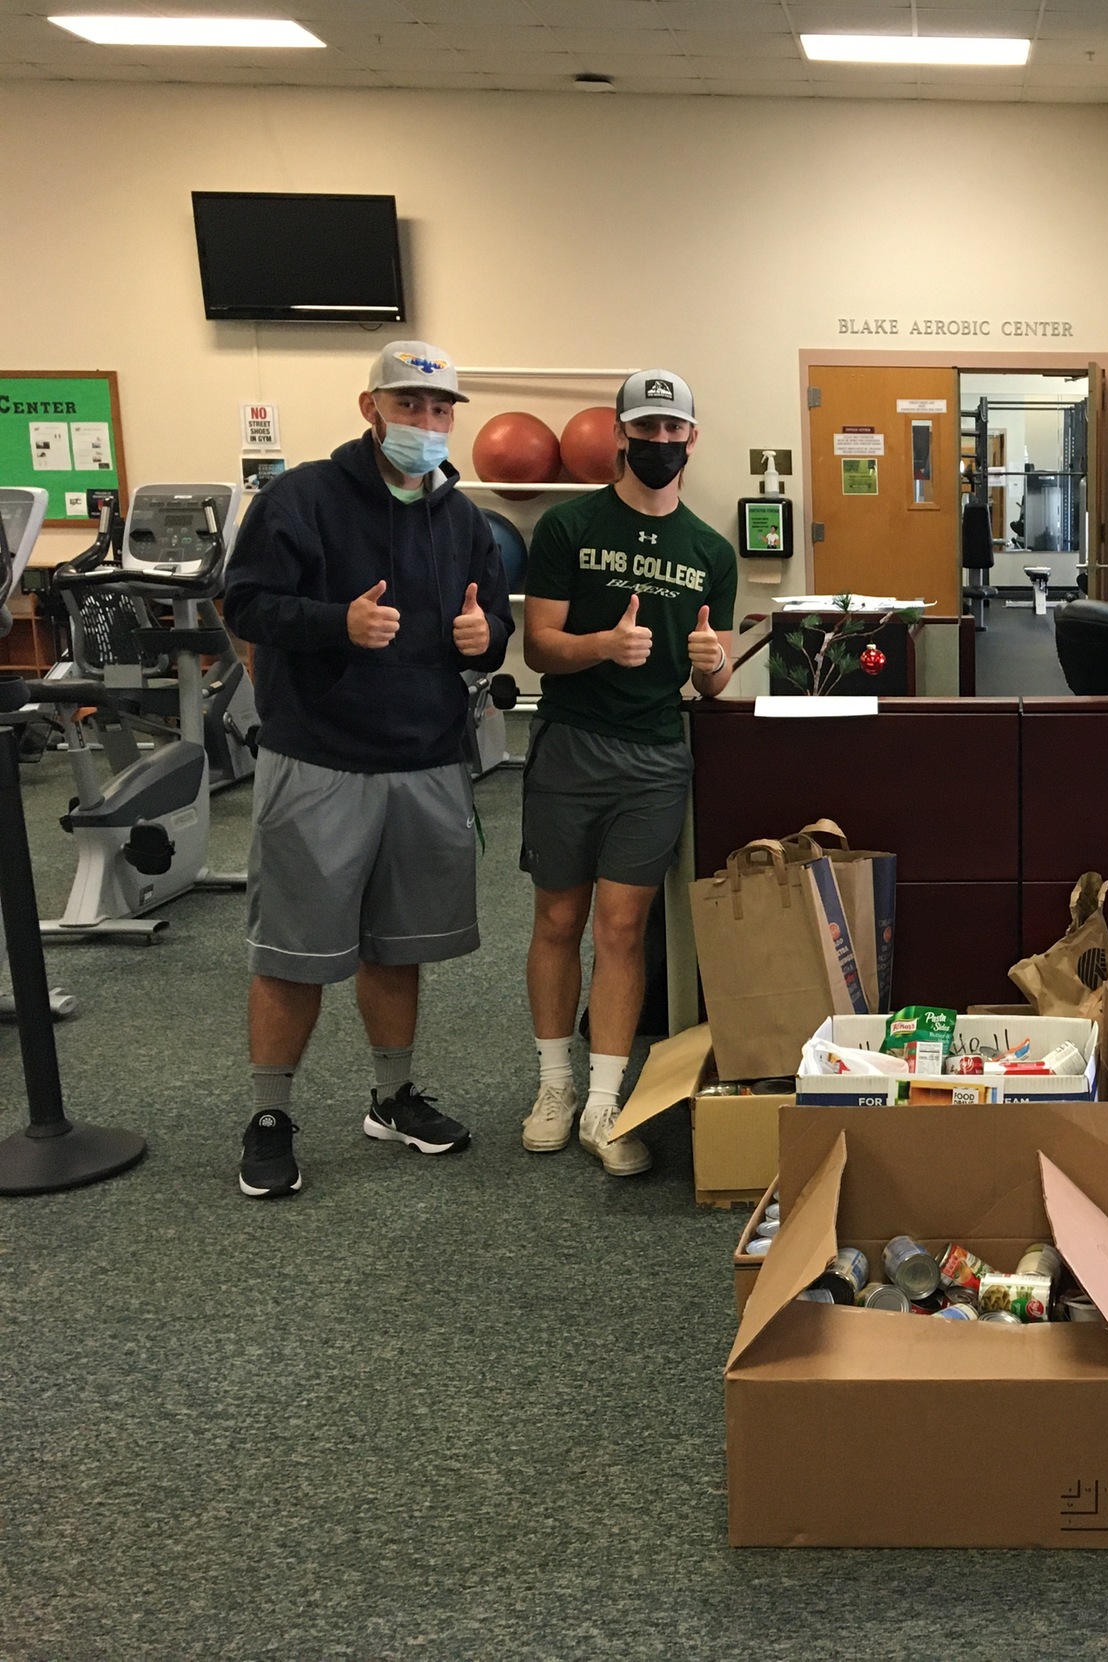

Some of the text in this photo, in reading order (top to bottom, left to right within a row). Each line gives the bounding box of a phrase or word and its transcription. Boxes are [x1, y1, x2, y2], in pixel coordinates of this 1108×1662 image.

[838, 318, 1074, 338] BLAKE AEROBIC CENTER
[251, 407, 267, 420] NO
[249, 420, 271, 428] STREET
[579, 547, 706, 592] ELMS COLLEGE
[925, 1012, 947, 1023] Pasta
[892, 1022, 916, 1031] Knorr
[932, 1022, 951, 1032] Sides
[858, 1097, 882, 1106] FOR
[953, 1092, 975, 1101] FOOD
